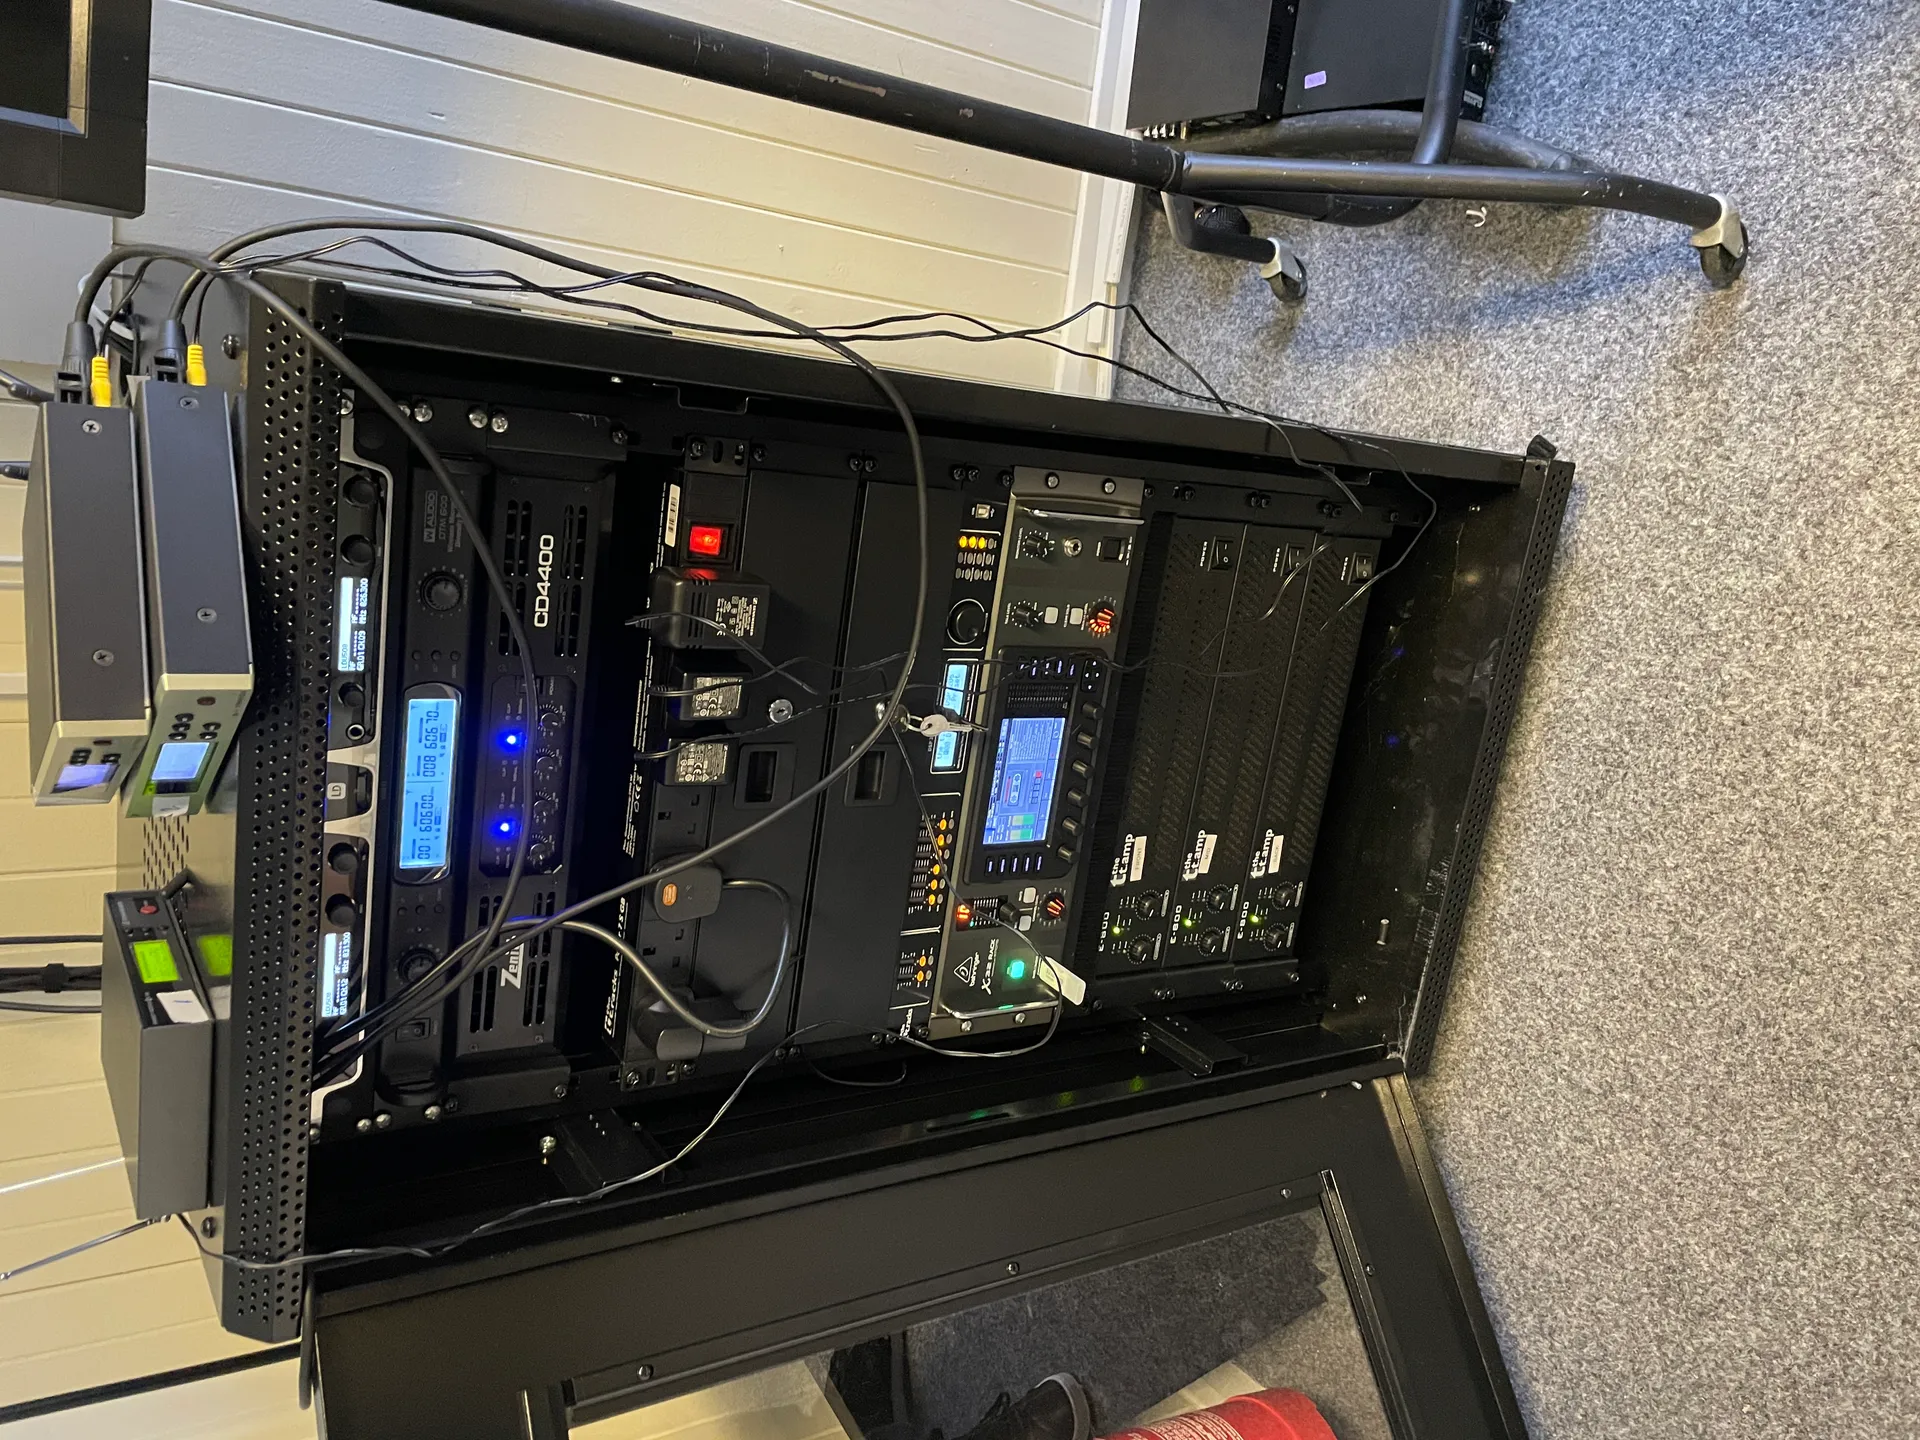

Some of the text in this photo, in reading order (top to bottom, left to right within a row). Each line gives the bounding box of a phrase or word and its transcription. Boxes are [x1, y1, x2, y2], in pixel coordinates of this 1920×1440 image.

[427, 492, 436, 527] AUDIO
[438, 518, 447, 540] DTM
[1200, 541, 1208, 567] POWER
[1272, 547, 1280, 573] POWER
[534, 534, 554, 628] CD4400
[1340, 556, 1349, 581] POWER
[422, 755, 436, 777] 008
[331, 785, 342, 797] LD
[417, 838, 430, 860] 001
[1183, 852, 1193, 870] the
[1252, 850, 1261, 868] the
[1111, 857, 1120, 874] the
[1170, 904, 1182, 944] E-800
[1236, 901, 1250, 940] E-800
[500, 935, 524, 989] Zeni
[969, 951, 980, 987] behringer
[981, 938, 996, 995] X32 RACK
